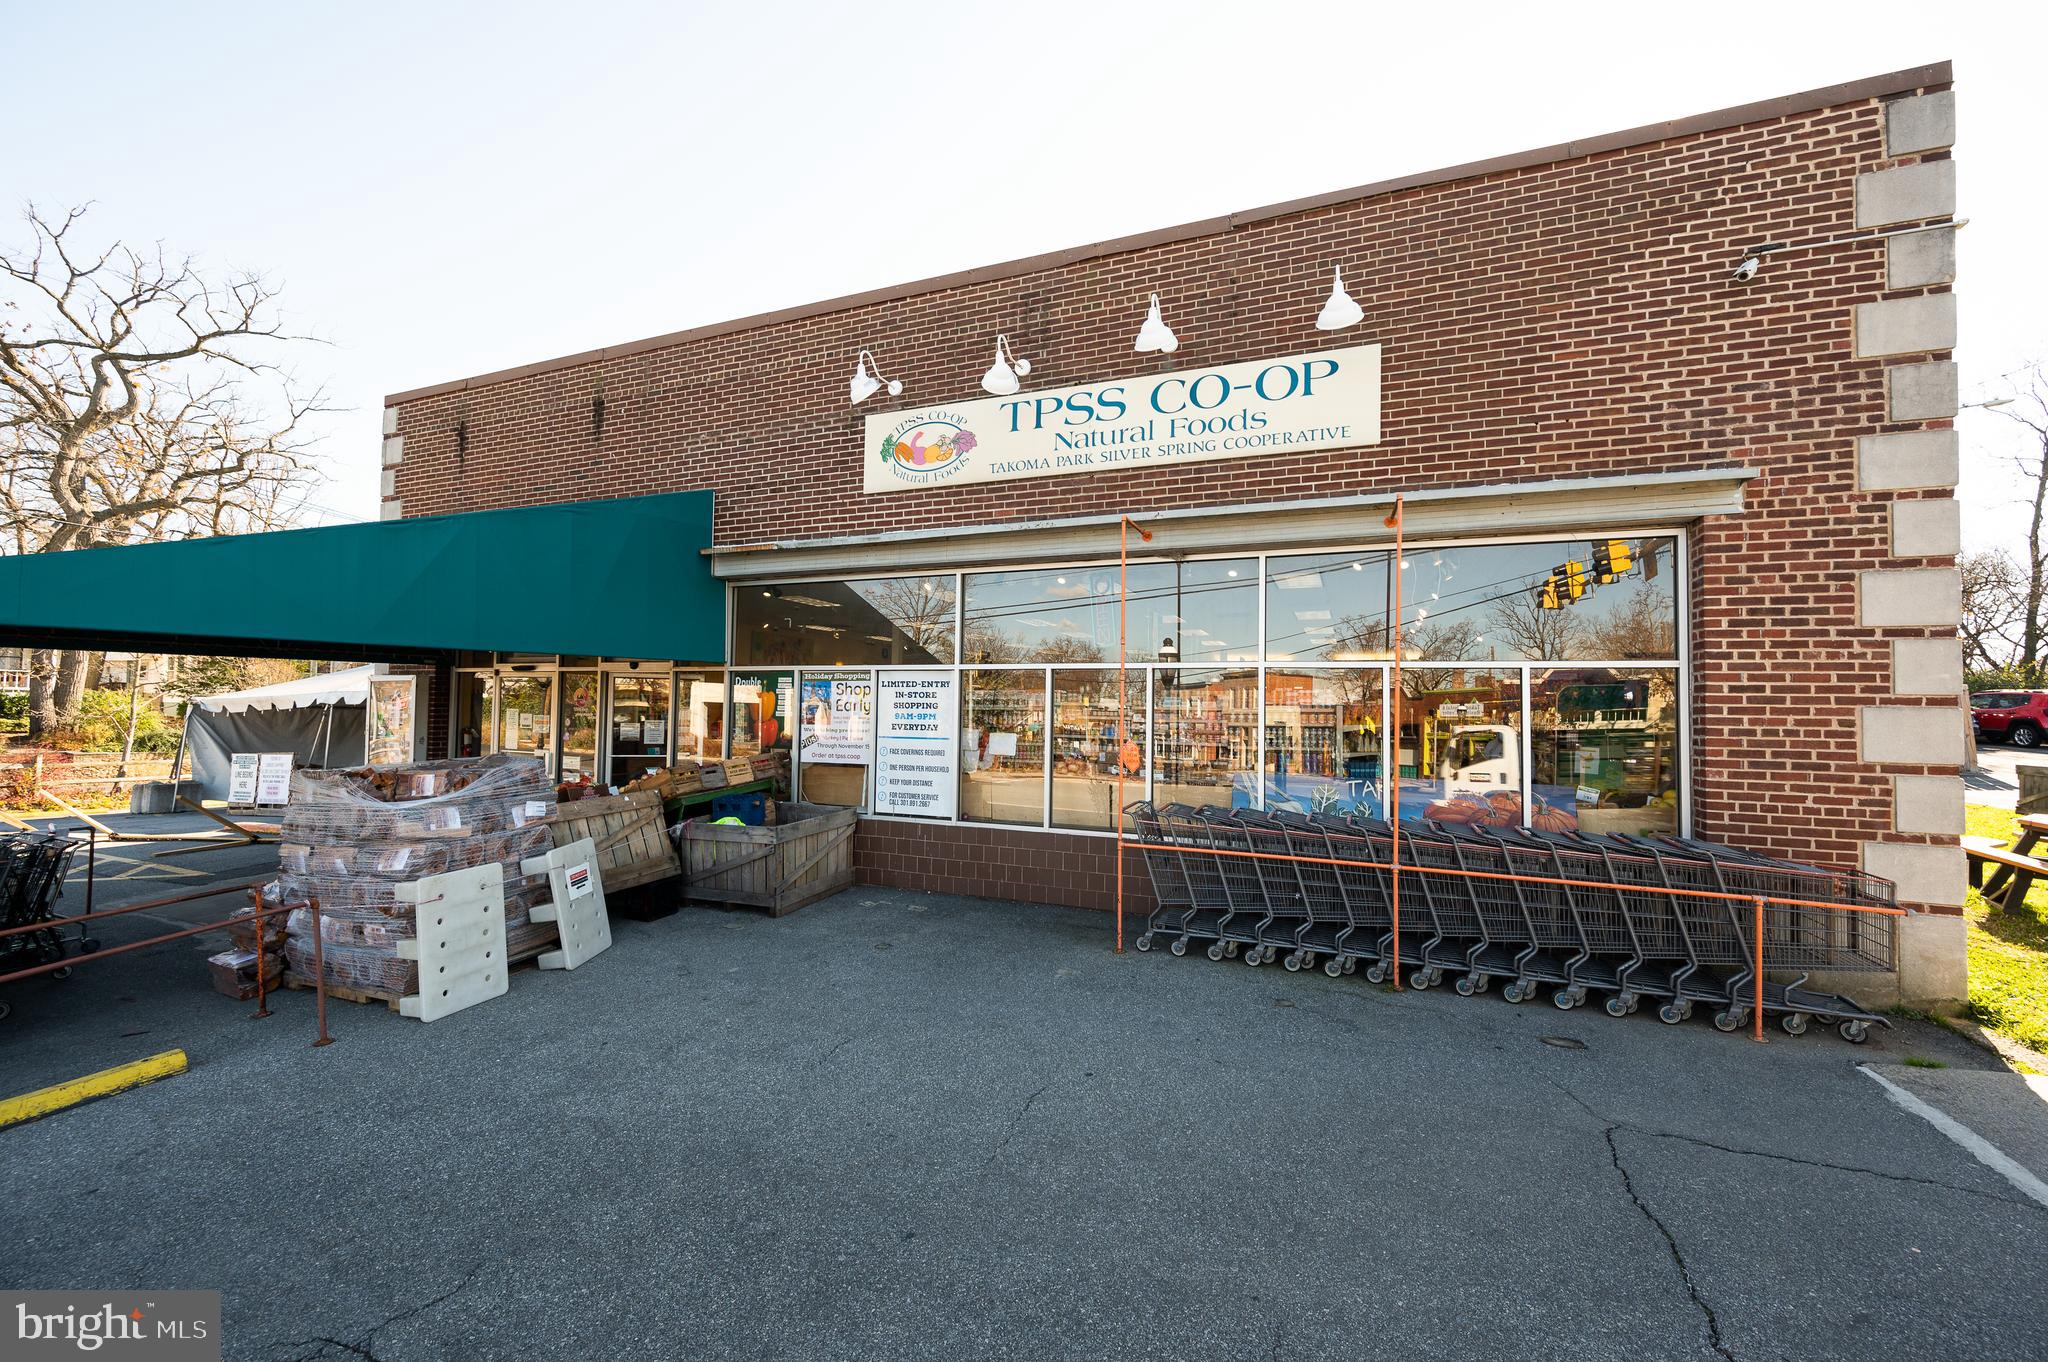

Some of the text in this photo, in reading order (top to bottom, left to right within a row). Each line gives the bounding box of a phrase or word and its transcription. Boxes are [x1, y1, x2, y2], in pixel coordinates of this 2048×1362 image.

[1000, 359, 1340, 432] TPSS CO-OP
[895, 410, 968, 434] TPSS CO-OP
[1053, 408, 1267, 451] Natural Foods
[989, 425, 1352, 474] TAKOMA PARK SILVER SPRING COOPERATIVE
[889, 456, 970, 483] Natural Foods
[735, 676, 762, 686] Double
[881, 680, 951, 688] LIMITED-ENTRY
[836, 682, 871, 698] Shop
[895, 691, 937, 699] IN-STORE
[836, 699, 871, 715] Early
[894, 712, 936, 720] 9AM-9PM
[891, 723, 939, 731] EVERYDAY
[900, 748, 924, 756] COVERINGS
[898, 792, 920, 800] CUSTOMER
[921, 793, 939, 801] SERVICE
